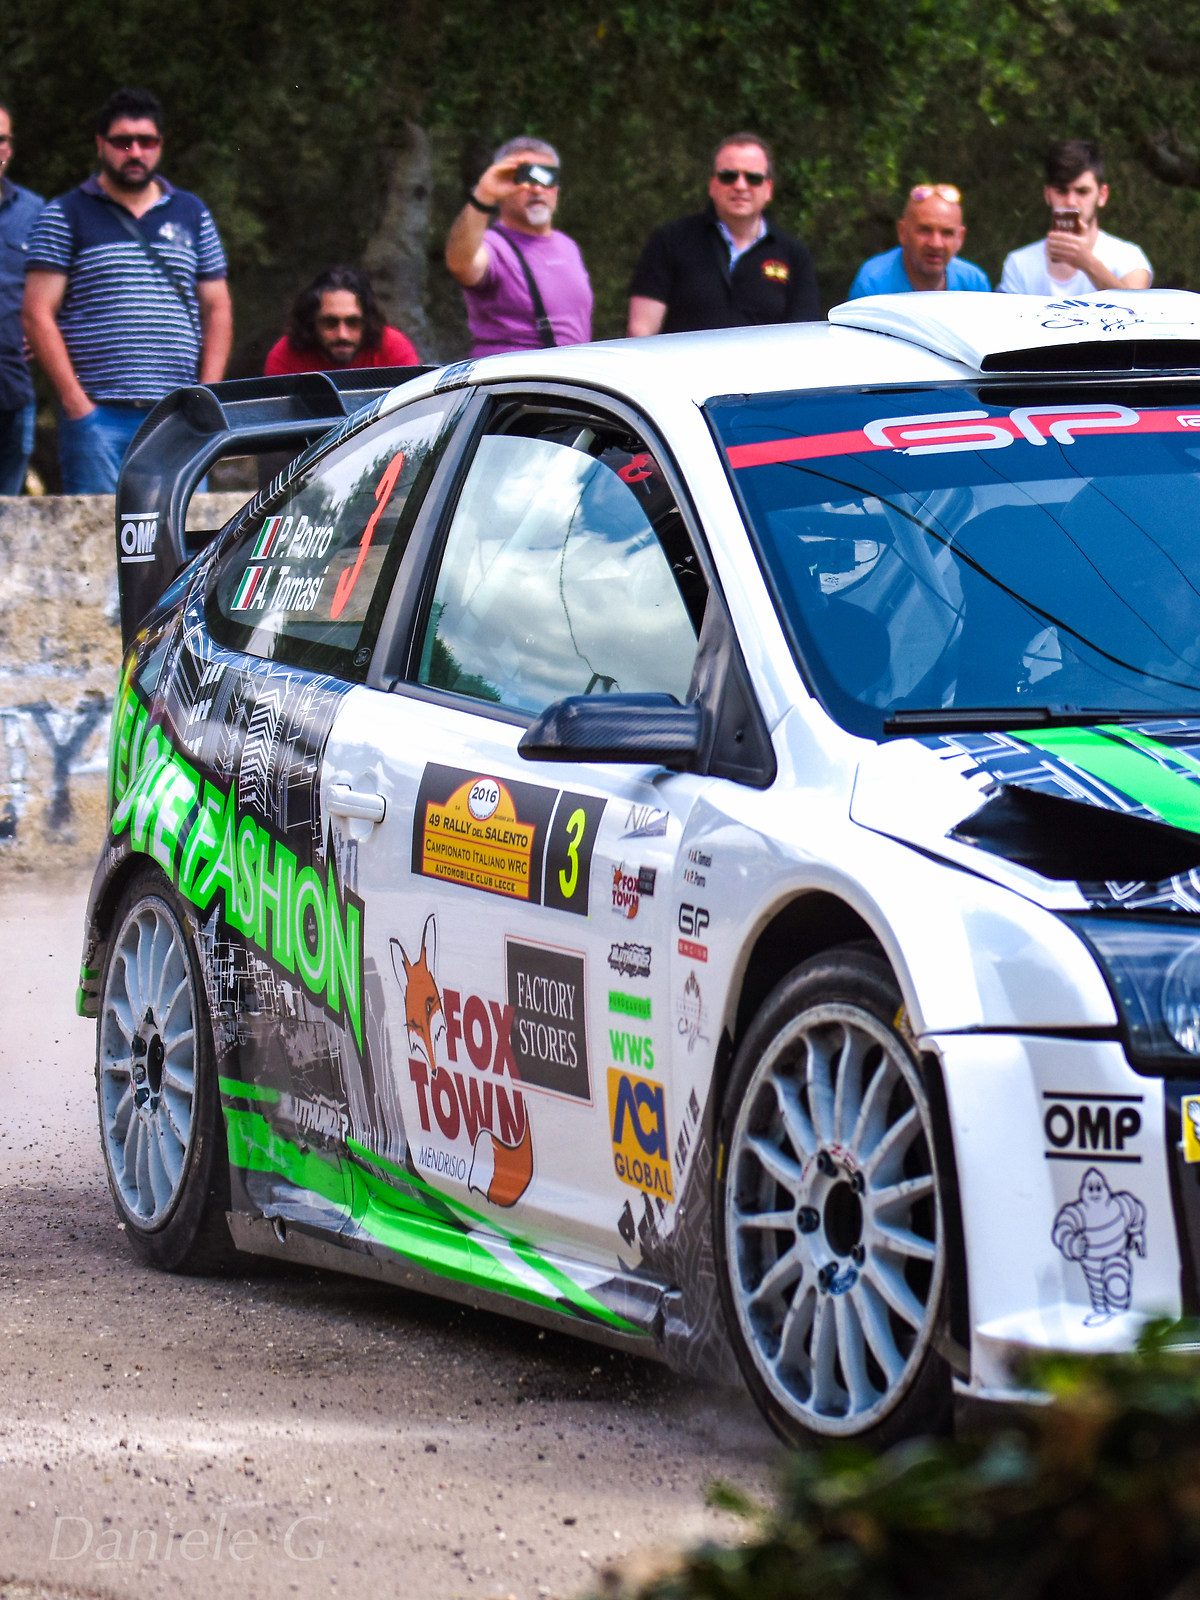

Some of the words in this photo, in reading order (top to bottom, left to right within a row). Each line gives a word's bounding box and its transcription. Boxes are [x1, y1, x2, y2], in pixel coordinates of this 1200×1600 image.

[862, 404, 1140, 456] GP
[120, 521, 157, 555] OMP
[271, 515, 293, 558] P.
[290, 515, 334, 559] Porro
[330, 451, 405, 620] 3
[250, 567, 270, 610] A.
[264, 566, 329, 612] Tomasi
[471, 787, 498, 803] 2016
[443, 816, 471, 835] RALLY
[472, 828, 484, 839] DEL
[484, 827, 528, 848] SALENTO
[558, 808, 586, 898] 3
[425, 838, 471, 861] CAMPIONATO
[472, 850, 506, 870] ITALIANO
[507, 858, 527, 875] WRC
[435, 863, 475, 882] AUTOMOBILE
[475, 874, 493, 886] CLUB
[494, 879, 516, 892] LECCE
[612, 890, 640, 907] TOWN
[622, 875, 640, 893] FOX
[181, 788, 361, 1036] FASHION
[678, 902, 710, 938] GP
[517, 971, 576, 1021] FACTORY
[443, 987, 521, 1081] FOX
[518, 1019, 578, 1069] STORES
[609, 1029, 654, 1070] WWS
[408, 1057, 526, 1147] TOWN
[1043, 1104, 1142, 1150] OMP
[418, 1146, 467, 1181] MENDRISIO
[615, 1152, 672, 1195] GLOBAL
